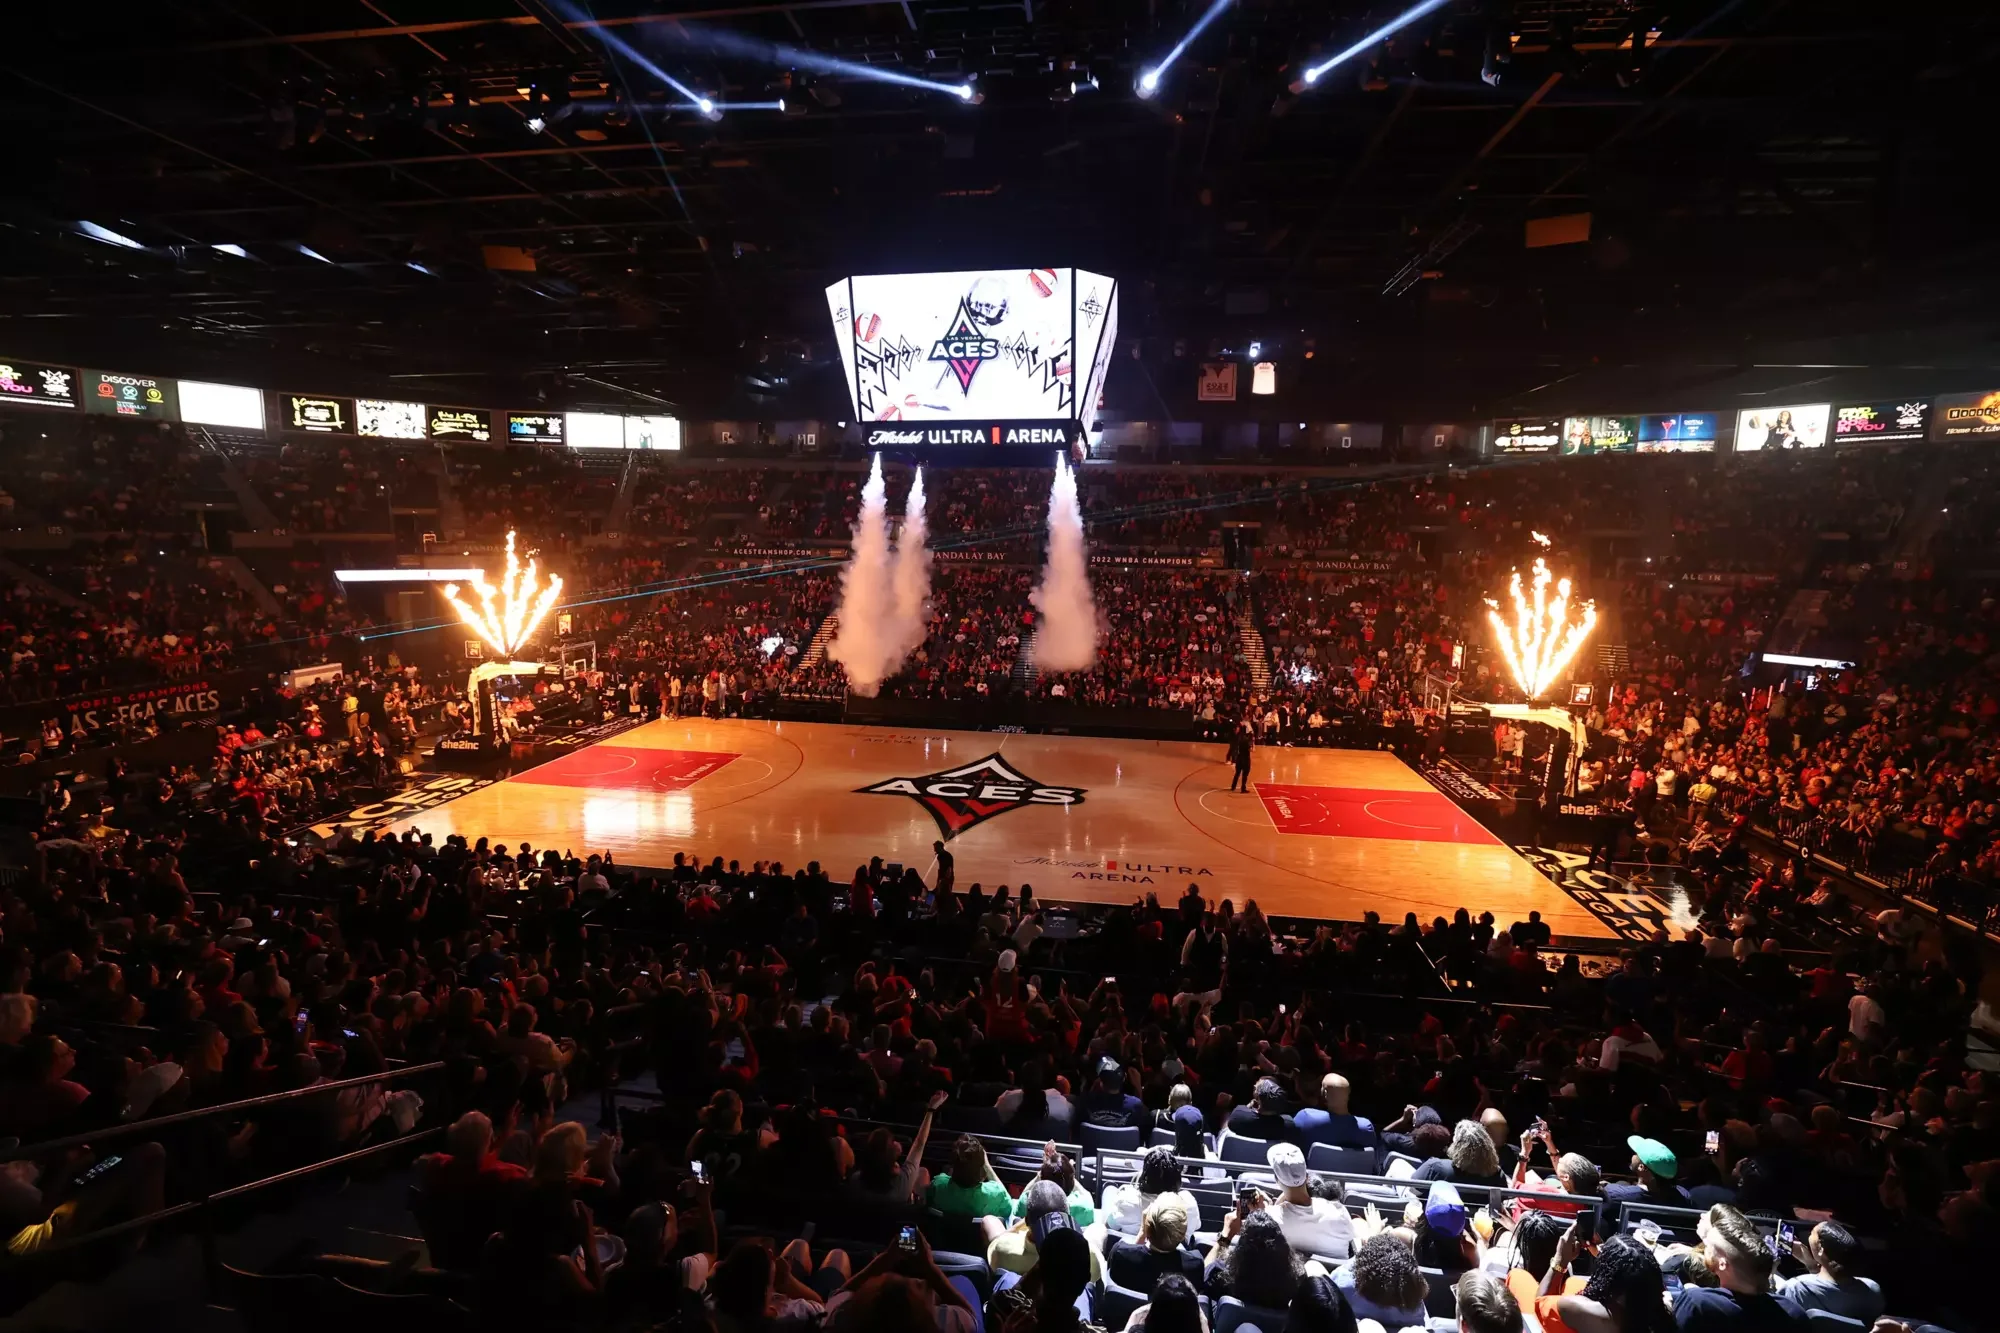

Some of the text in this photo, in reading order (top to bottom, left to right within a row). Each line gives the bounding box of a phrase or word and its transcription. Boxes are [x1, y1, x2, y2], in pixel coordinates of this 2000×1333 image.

[932, 341, 998, 358] ACES
[101, 374, 156, 387] DISCOVER
[1856, 423, 1885, 432] YOU
[868, 428, 1066, 446] Michelob ULTRA ARENA
[733, 548, 812, 556] ACESTEAMSHOP.COM
[932, 551, 1006, 560] ANDALAY BAY
[1114, 556, 1139, 564] WNBA
[1142, 557, 1193, 565] CHAMPIONS
[1316, 561, 1391, 570] MANDALAY BAY
[129, 681, 209, 701] CHAMPIONS
[71, 711, 100, 733] AS
[175, 690, 220, 713] ACES
[441, 740, 480, 750] she2inc
[973, 779, 1033, 787] VEGAS
[869, 779, 1076, 804] ACES
[1801, 846, 1809, 859] C
[1125, 862, 1214, 877] ULTRA
[1071, 871, 1155, 884] ARENA
[1514, 845, 1652, 942] LAS VEGAS
